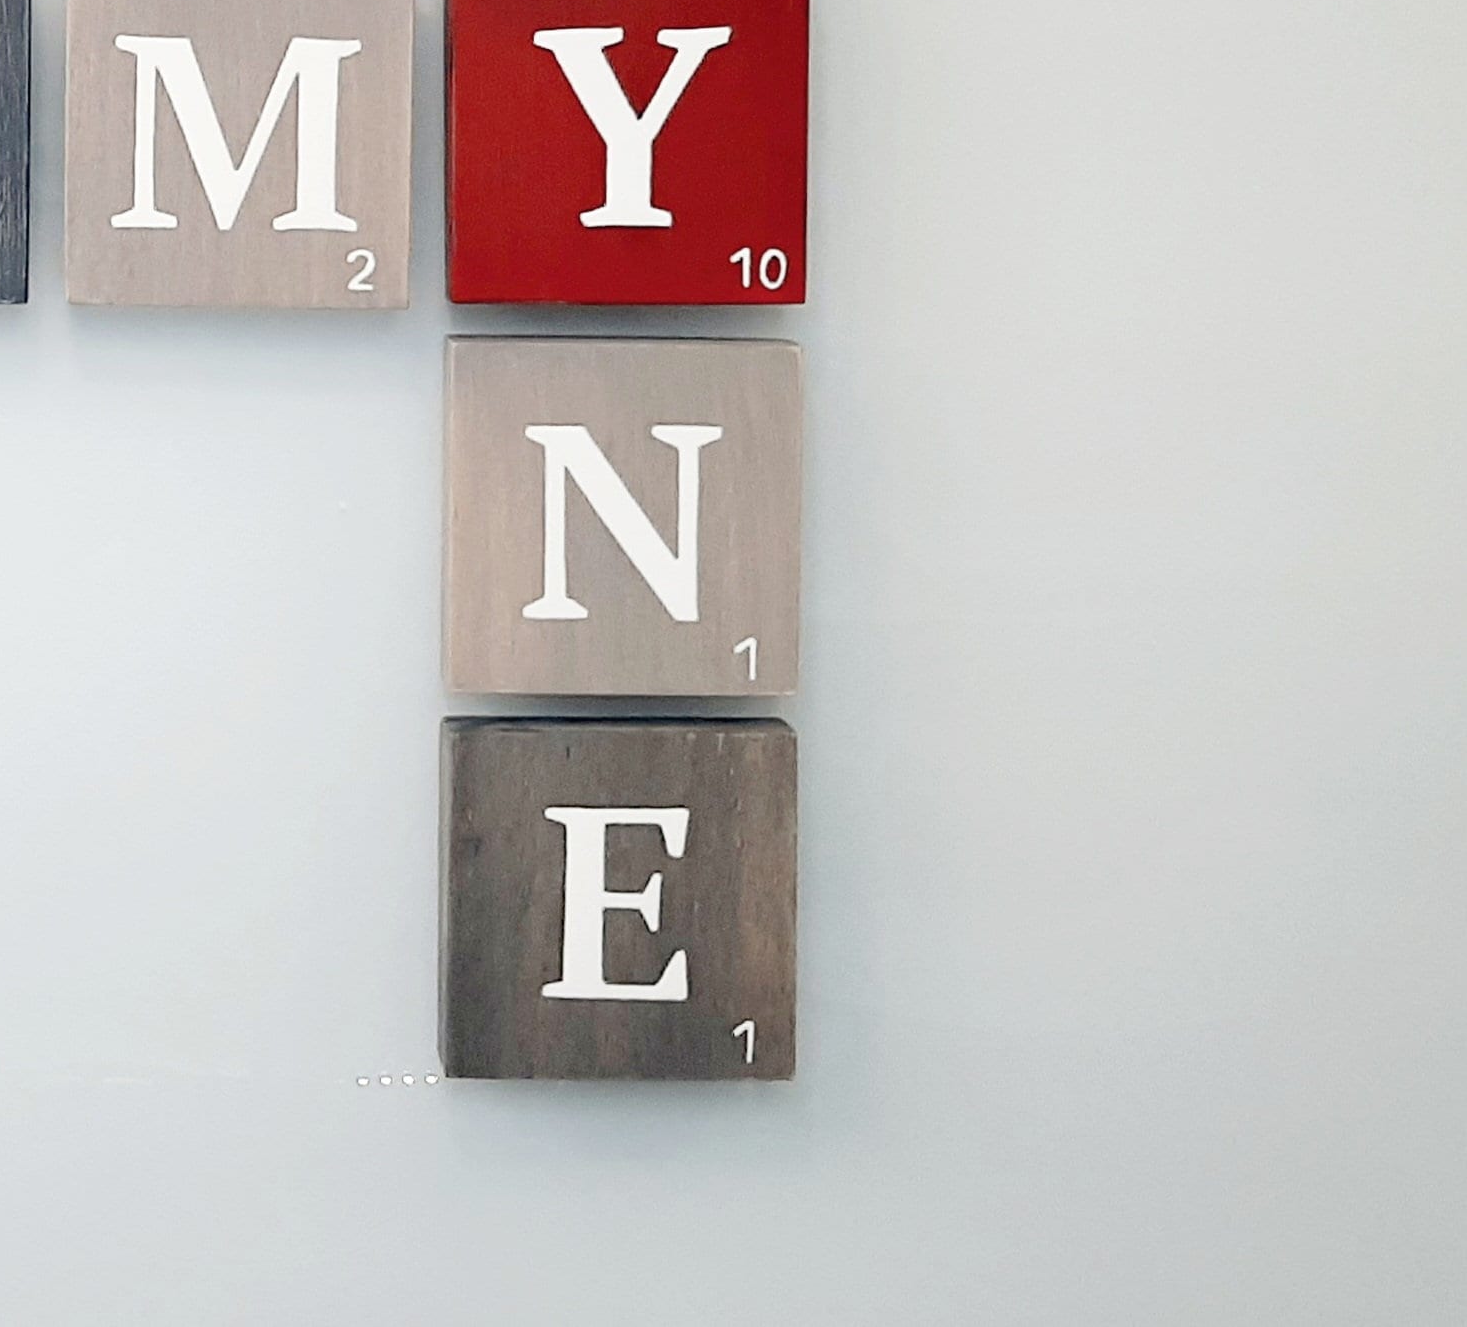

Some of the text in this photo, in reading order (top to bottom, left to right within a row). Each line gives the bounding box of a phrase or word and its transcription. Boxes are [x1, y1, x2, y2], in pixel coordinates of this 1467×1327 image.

[346, 249, 376, 292] 2
[729, 247, 787, 289] 10
[734, 637, 757, 681] 1
[732, 1020, 755, 1063] 1
